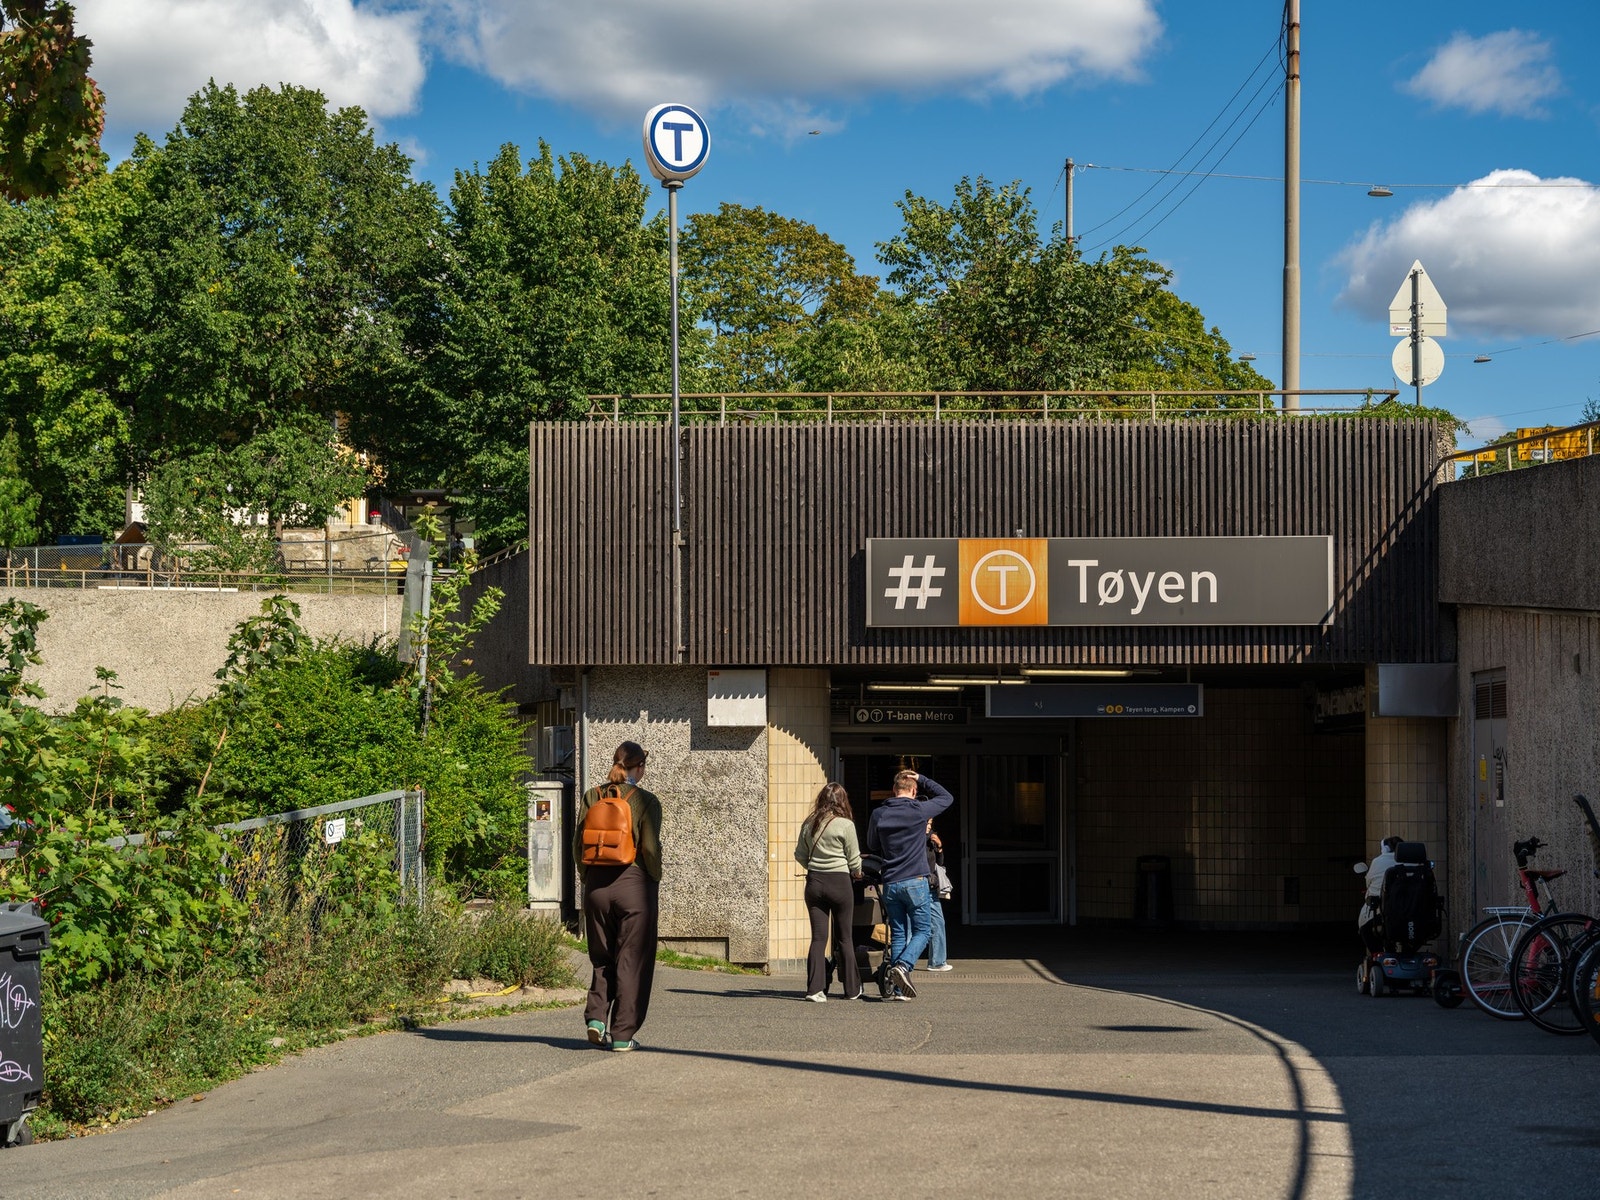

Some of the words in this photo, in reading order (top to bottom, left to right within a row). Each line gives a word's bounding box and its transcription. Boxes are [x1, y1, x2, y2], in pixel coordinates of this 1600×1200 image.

[662, 121, 694, 162] T
[987, 565, 1019, 606] T
[1067, 558, 1219, 616] Tøyen
[886, 710, 922, 721] T-bane
[925, 710, 954, 721] Metro
